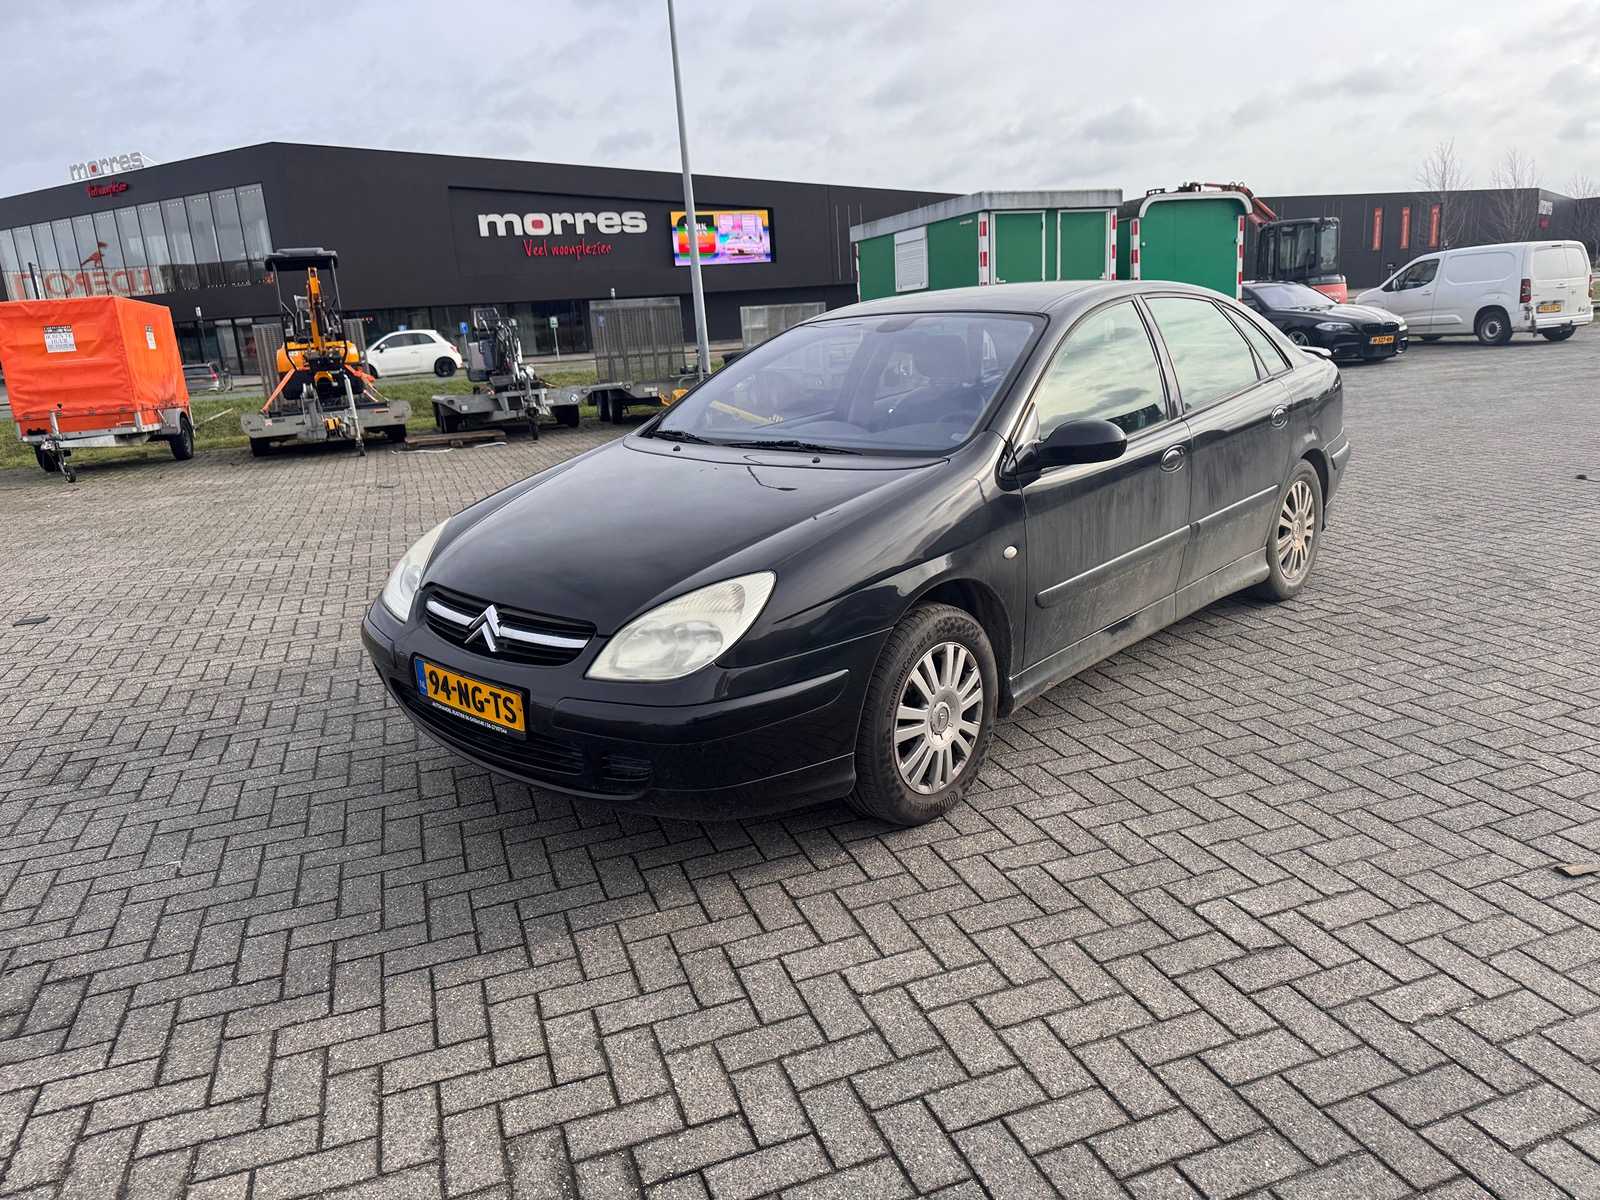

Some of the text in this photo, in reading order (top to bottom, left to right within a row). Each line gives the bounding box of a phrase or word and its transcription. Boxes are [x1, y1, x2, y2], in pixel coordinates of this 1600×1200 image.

[69, 152, 144, 180] morres
[478, 211, 648, 237] morres
[524, 238, 612, 261] Veel woonplezier
[428, 669, 517, 724] 94-NG-TS
